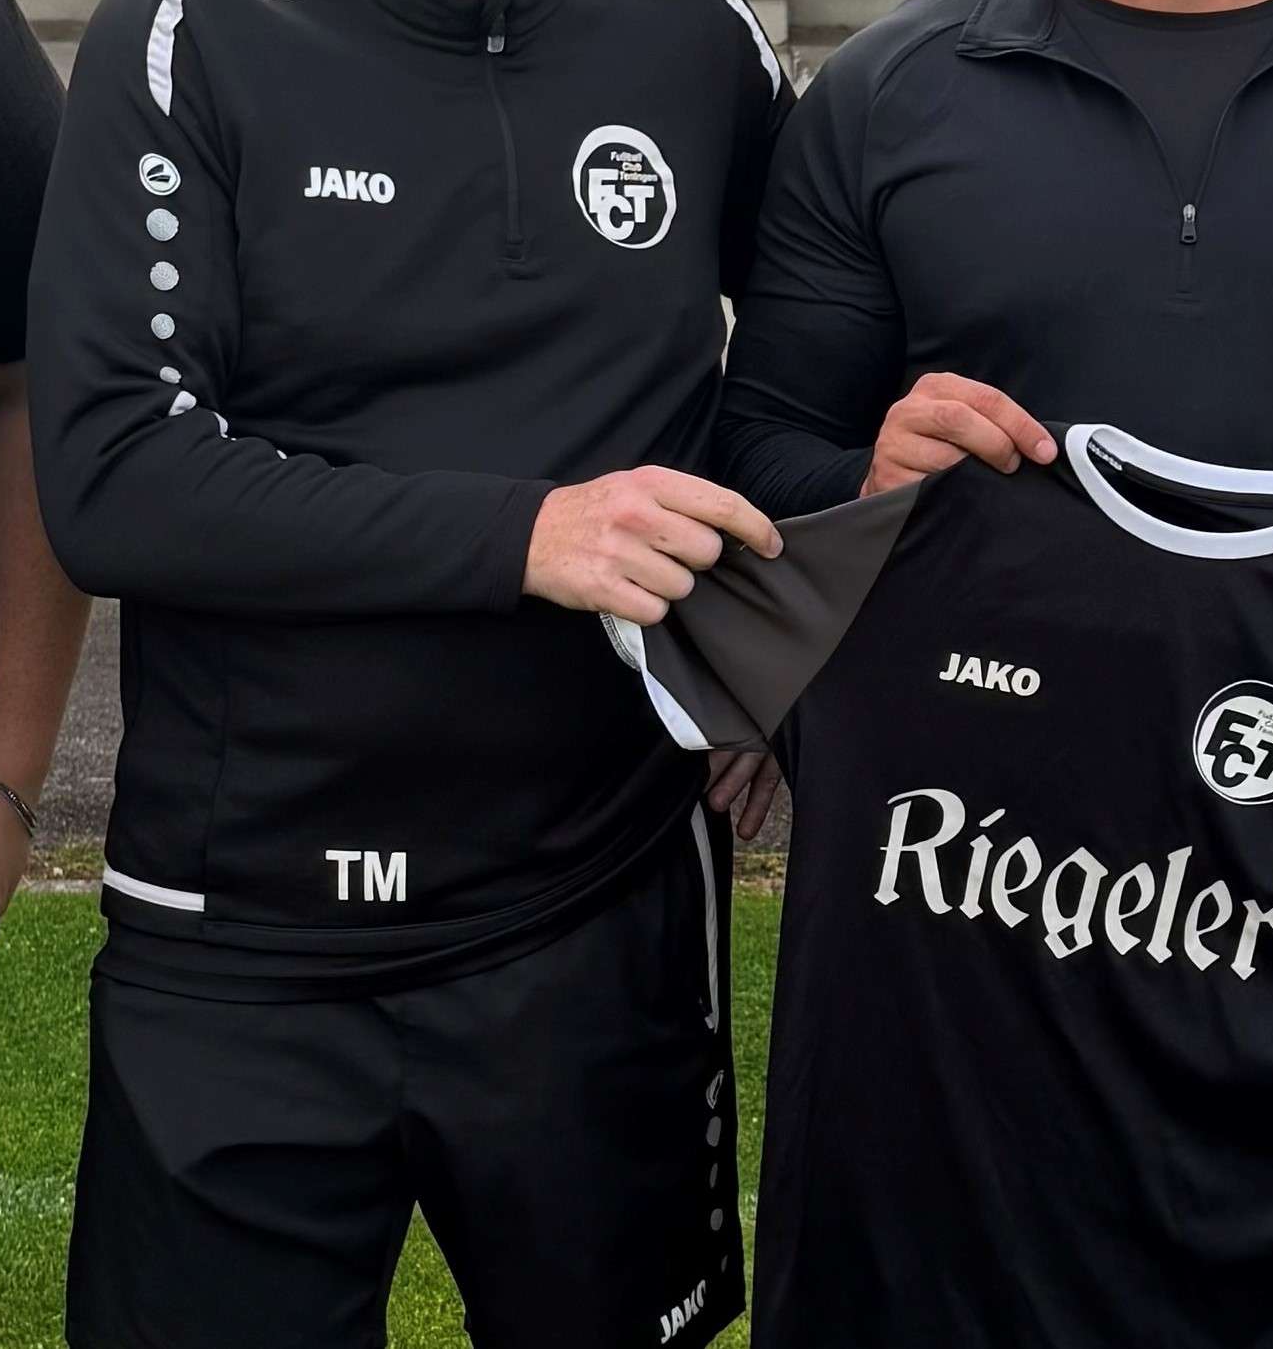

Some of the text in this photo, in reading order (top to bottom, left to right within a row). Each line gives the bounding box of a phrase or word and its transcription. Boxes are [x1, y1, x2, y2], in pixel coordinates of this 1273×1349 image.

[303, 166, 396, 204] JAKO
[939, 652, 1041, 697] JAKO
[325, 849, 407, 902] TM
